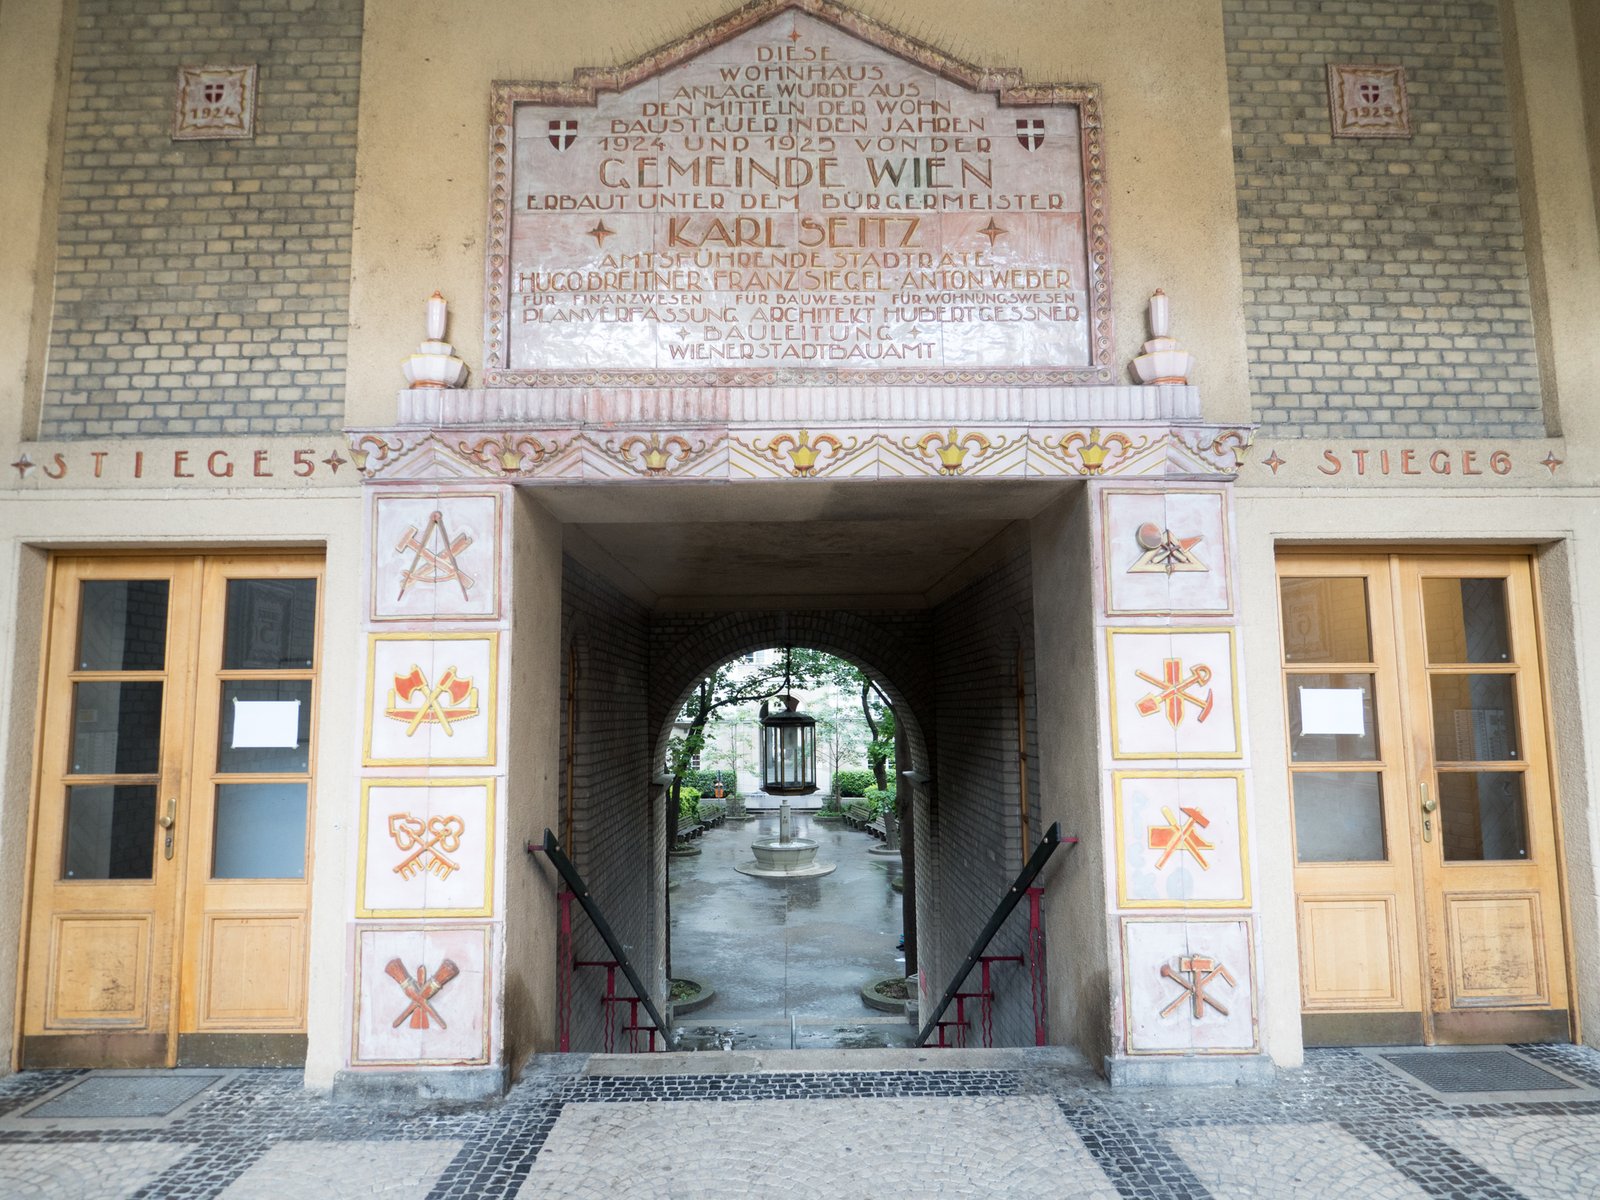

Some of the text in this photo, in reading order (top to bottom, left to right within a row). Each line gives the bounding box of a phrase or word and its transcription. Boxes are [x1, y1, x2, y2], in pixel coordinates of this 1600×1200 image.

[757, 46, 837, 62] DIESE
[720, 66, 883, 81] WOHNHAUS
[673, 82, 920, 99] ANLAGE WURDE AUS
[190, 107, 235, 119] 1924
[642, 100, 951, 117] DEN MITTELN DER WOHN
[1350, 106, 1394, 118] 1925
[610, 117, 778, 134] BAUSTEUER
[882, 117, 985, 133] JAHREN
[599, 136, 992, 152] 1924 UND 1925 VON DER
[599, 156, 993, 189] GEMEINDE WIEN
[527, 191, 1064, 211] ERBAUT UNTER DEM BÜRGERMEISTER
[668, 215, 922, 249] KARL SEITZ
[602, 248, 827, 269] AMTSFÜHRENDE
[519, 269, 1071, 292] HUGO BREITNER FRANZ SIEGEL ANTON WEBER
[523, 291, 1076, 306] FÜR FINANZWESEN FÜR BAUWESEN FÜR WOHNUNGSWESEN
[522, 306, 1080, 323] PLANVERFASSUNG ARCHITEKT HUBERT GESSNER
[704, 325, 892, 341] BAULEITUNG
[43, 449, 316, 479] STIEGE 5
[1317, 449, 1513, 475] STIEGE 6
